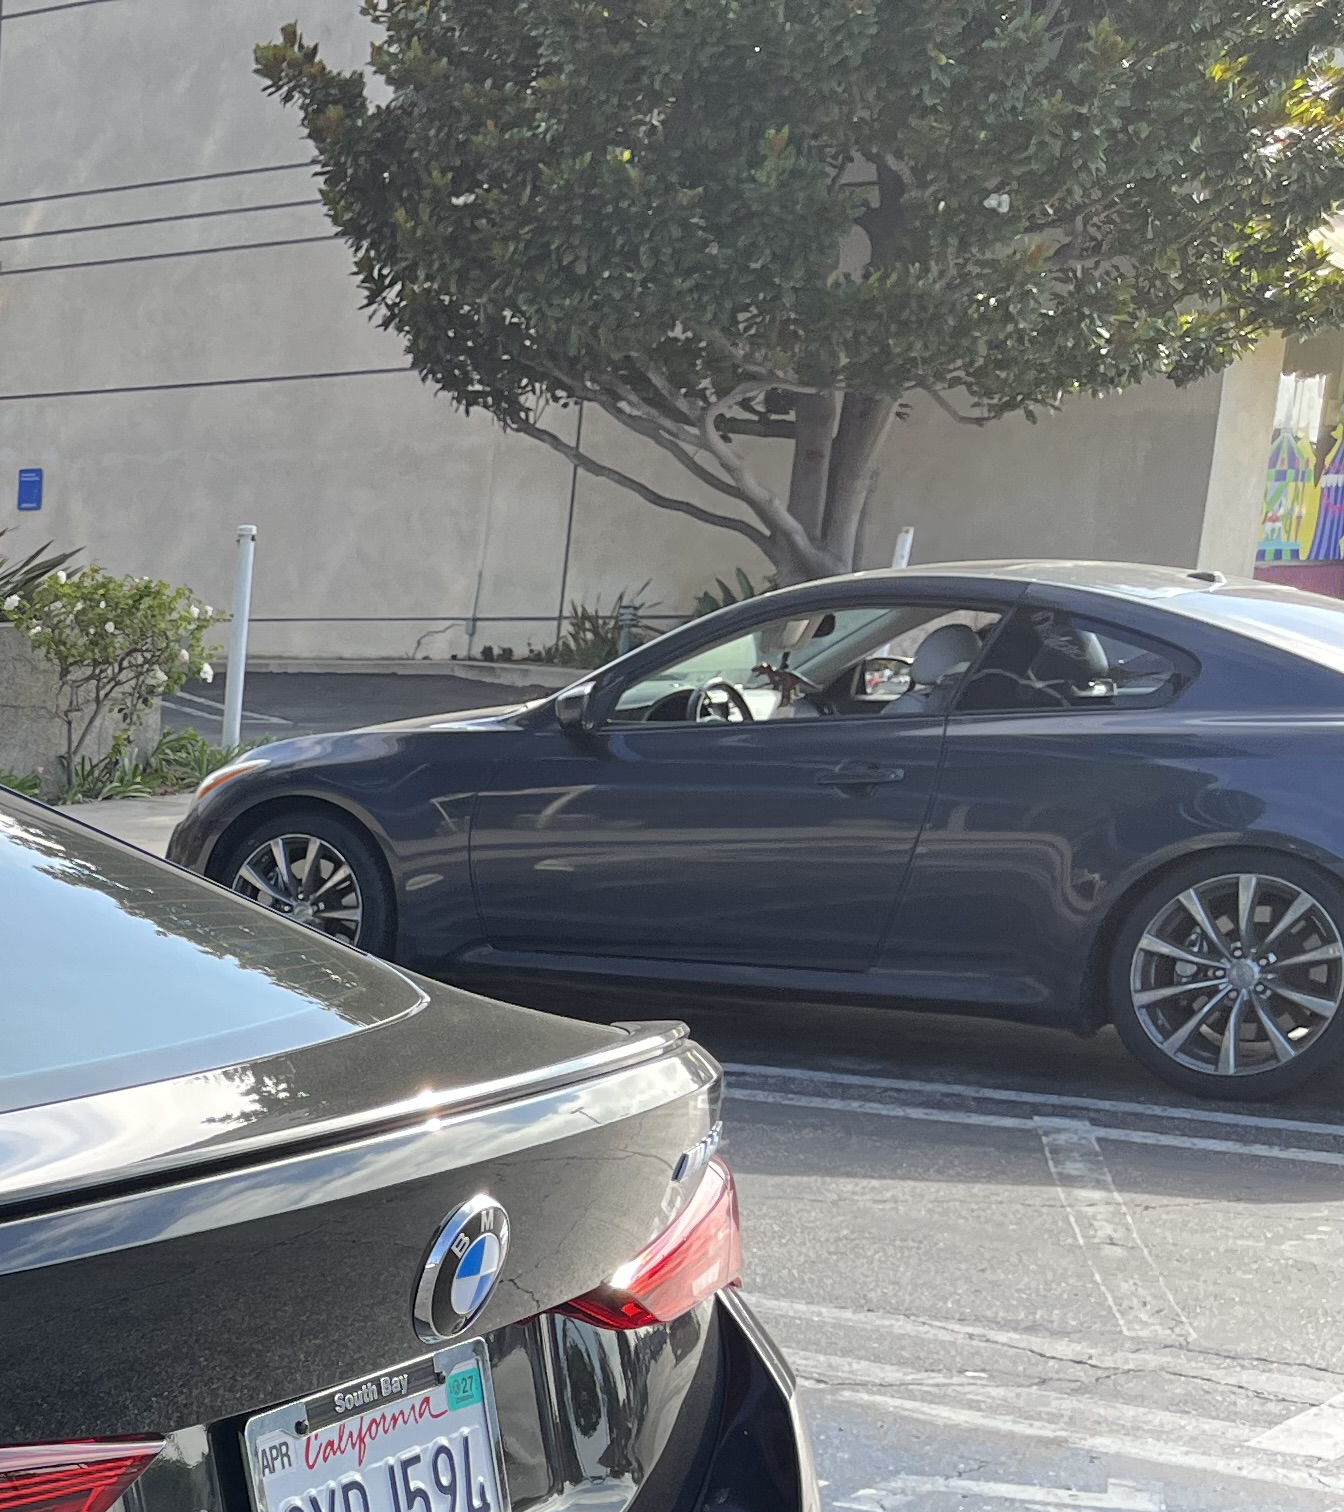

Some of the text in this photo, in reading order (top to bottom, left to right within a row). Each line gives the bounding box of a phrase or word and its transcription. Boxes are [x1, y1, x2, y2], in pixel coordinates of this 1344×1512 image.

[334, 1373, 409, 1414] South Bay
[305, 1396, 449, 1470] California
[261, 1441, 292, 1477] APR
